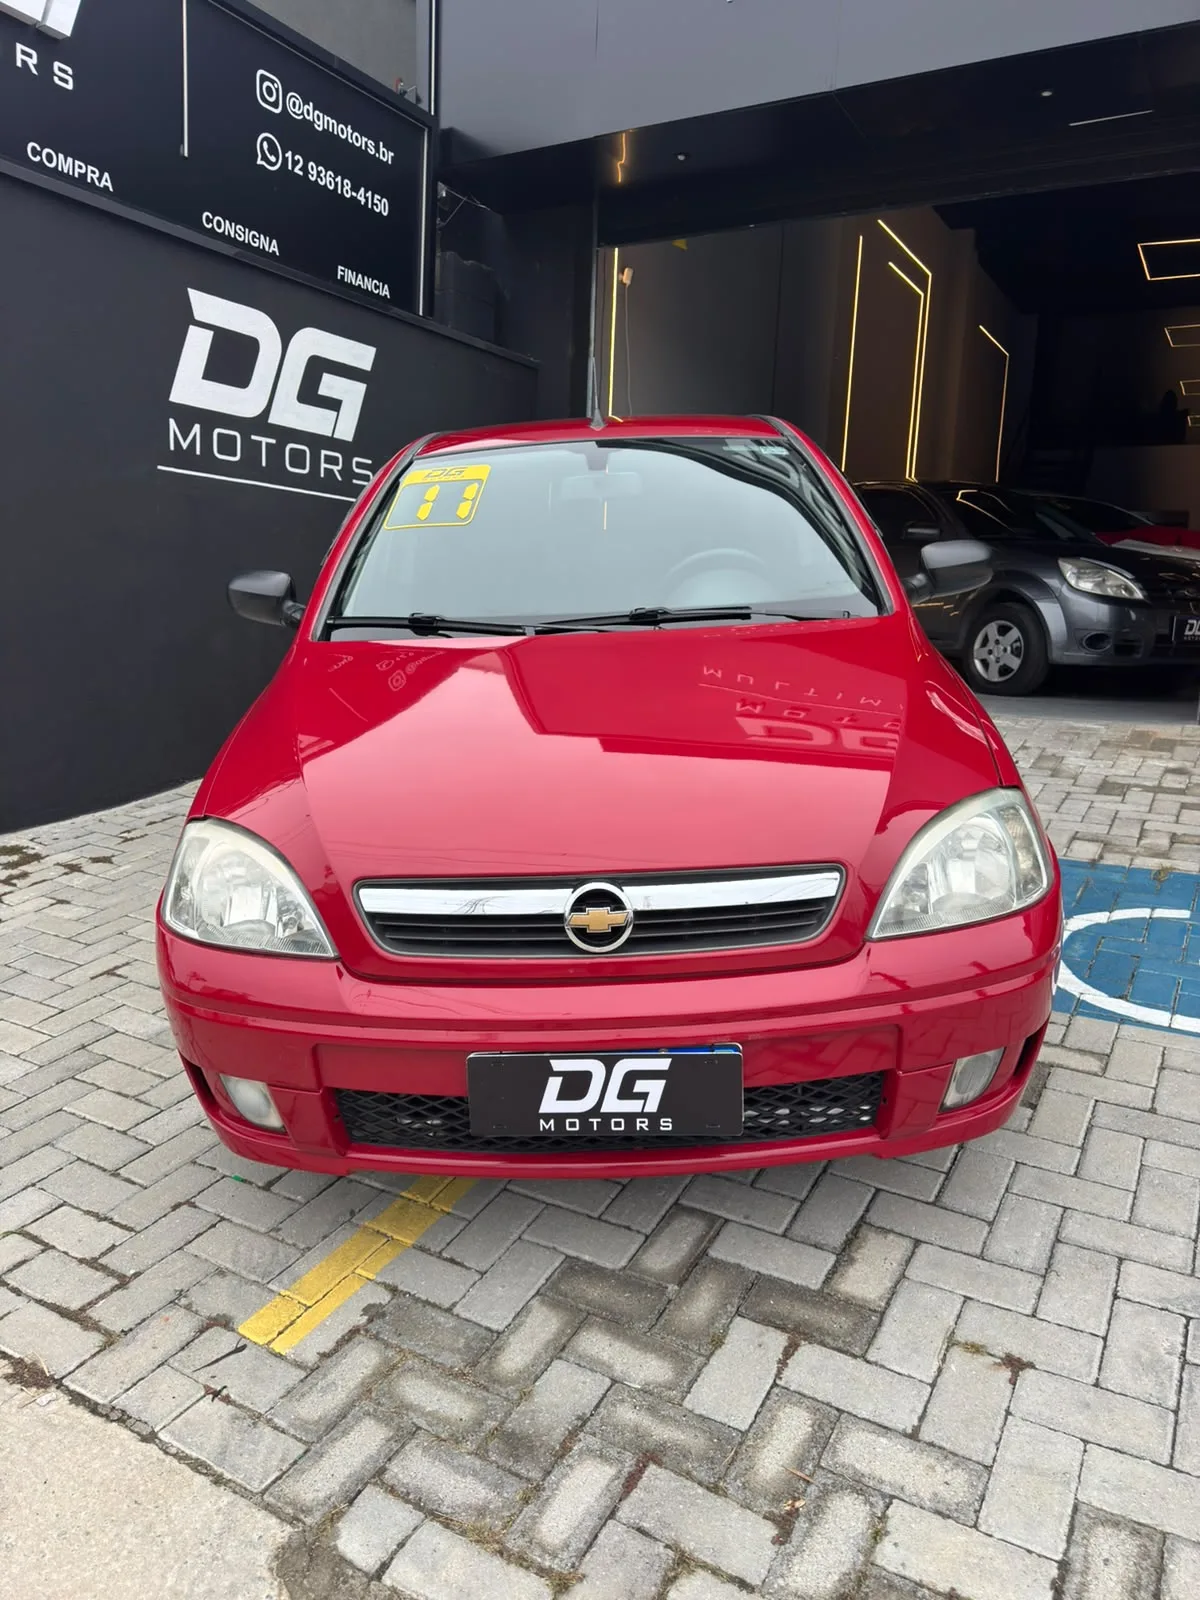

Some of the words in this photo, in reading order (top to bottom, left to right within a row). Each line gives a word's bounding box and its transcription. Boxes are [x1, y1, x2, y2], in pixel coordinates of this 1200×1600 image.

[286, 91, 395, 165] @dgmotors.br
[26, 141, 114, 192] COMPRA
[285, 150, 304, 176] 12
[307, 164, 390, 217] 93618-4150
[202, 211, 280, 256] CONSIGNA
[337, 265, 391, 299] FINANCIA
[168, 287, 377, 442] DG
[168, 417, 373, 485] MOTORS
[538, 1057, 673, 1114] DG
[539, 1117, 673, 1132] MOTORS
